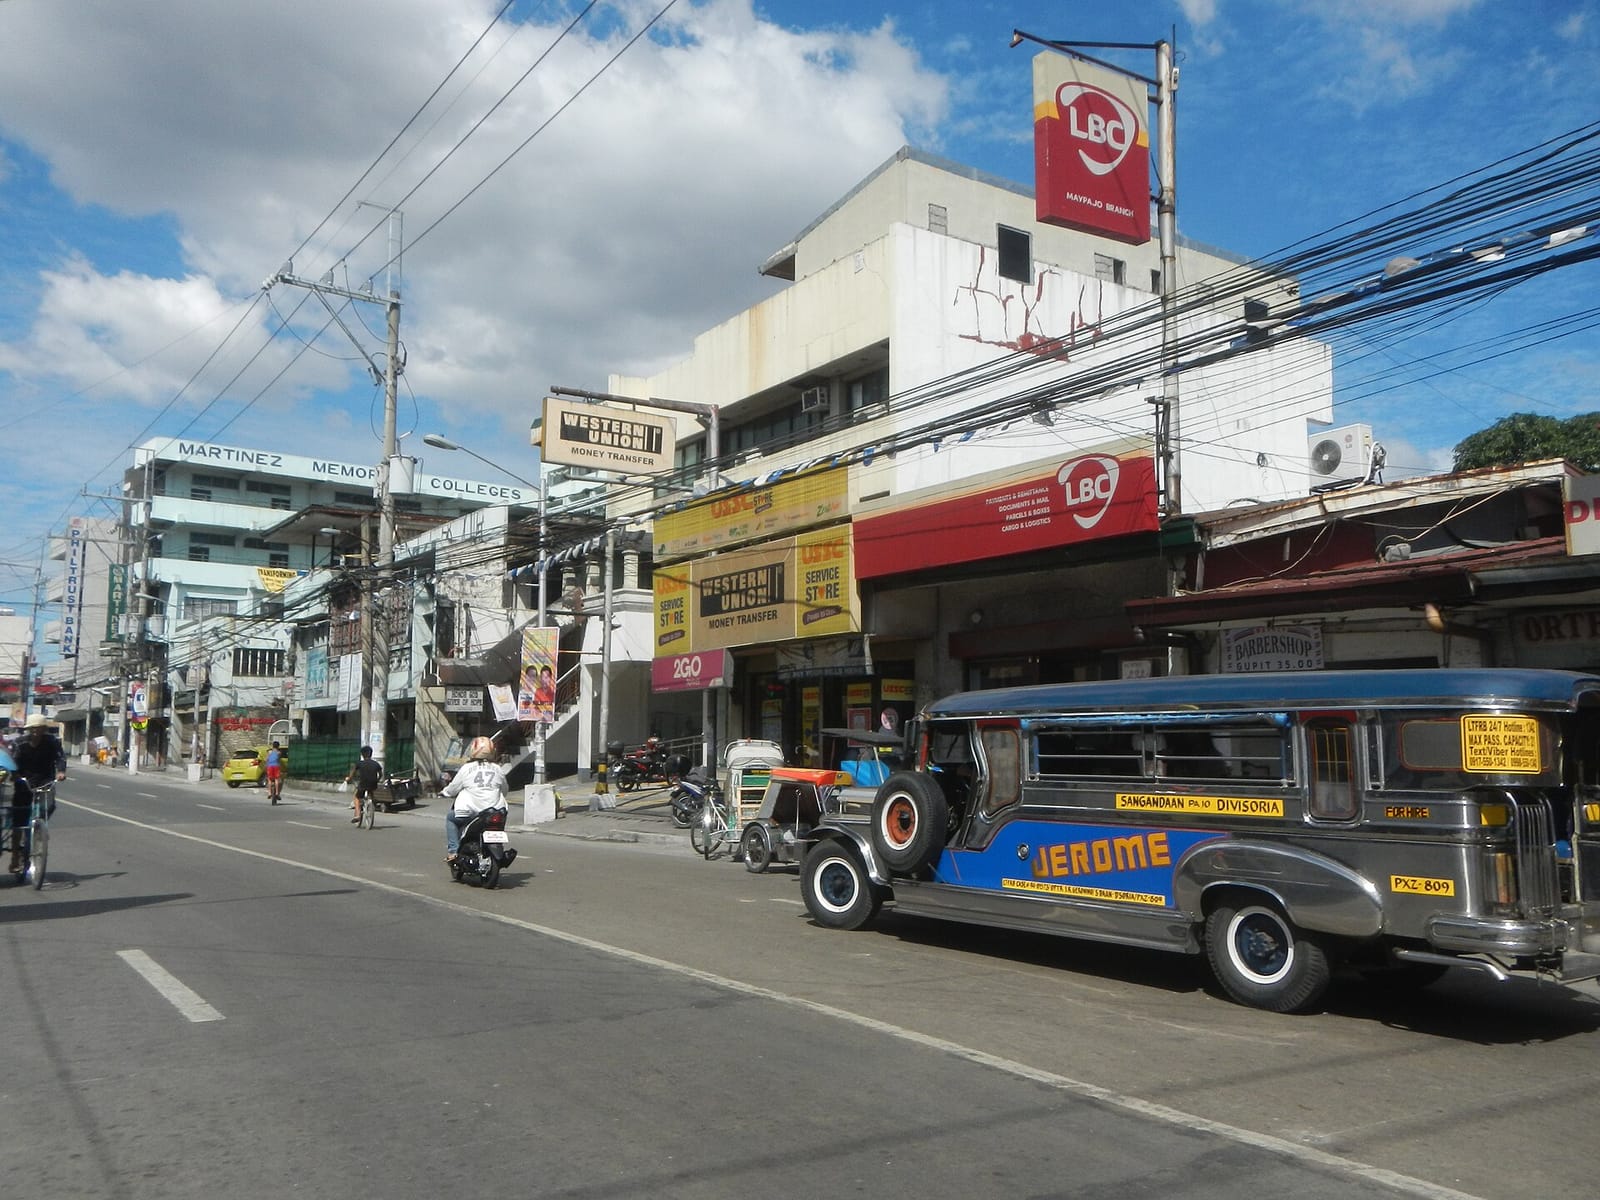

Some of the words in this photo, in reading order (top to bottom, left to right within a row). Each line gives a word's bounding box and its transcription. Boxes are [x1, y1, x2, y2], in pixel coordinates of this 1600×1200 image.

[1069, 106, 1126, 150] LBC
[1066, 191, 1103, 209] MAYPAJO
[1105, 201, 1134, 217] BRANCH
[563, 413, 644, 437] WESTERN
[588, 430, 643, 450] UNION
[571, 447, 605, 457] MONEY
[608, 452, 654, 466] TRANSFER
[179, 442, 282, 468] MARTINEZ
[313, 461, 376, 480] MEMOR
[431, 478, 521, 500] COLLEGES
[1065, 473, 1110, 506] LBC
[998, 500, 1030, 513] DOCUMENTS
[1036, 496, 1050, 505] MAIL
[1006, 511, 1028, 521] PARCELS
[1033, 506, 1050, 516] BOXES
[1001, 523, 1019, 532] CARGO
[1025, 517, 1051, 528] LOGISTICS
[67, 529, 80, 613] PHILTRUST
[805, 566, 840, 584] SERVICE
[702, 568, 767, 597] WESTERN
[660, 597, 684, 612] SERVICE
[721, 587, 767, 611] UNION
[708, 616, 735, 629] MONEY
[736, 609, 778, 625] TRANSFER
[63, 616, 75, 653] BANK
[1234, 635, 1312, 661] BARBERSHOP
[673, 655, 702, 678] 2GO
[1236, 660, 1271, 671] GUPIT
[1277, 659, 1313, 669] 35.00
[1467, 720, 1487, 731] LTFRB
[1468, 735, 1482, 745] MAX
[473, 771, 496, 787] 47
[1120, 795, 1184, 809] SANGANDAAN
[1216, 799, 1280, 814] DIVISORIA
[1032, 831, 1172, 879] JEROME
